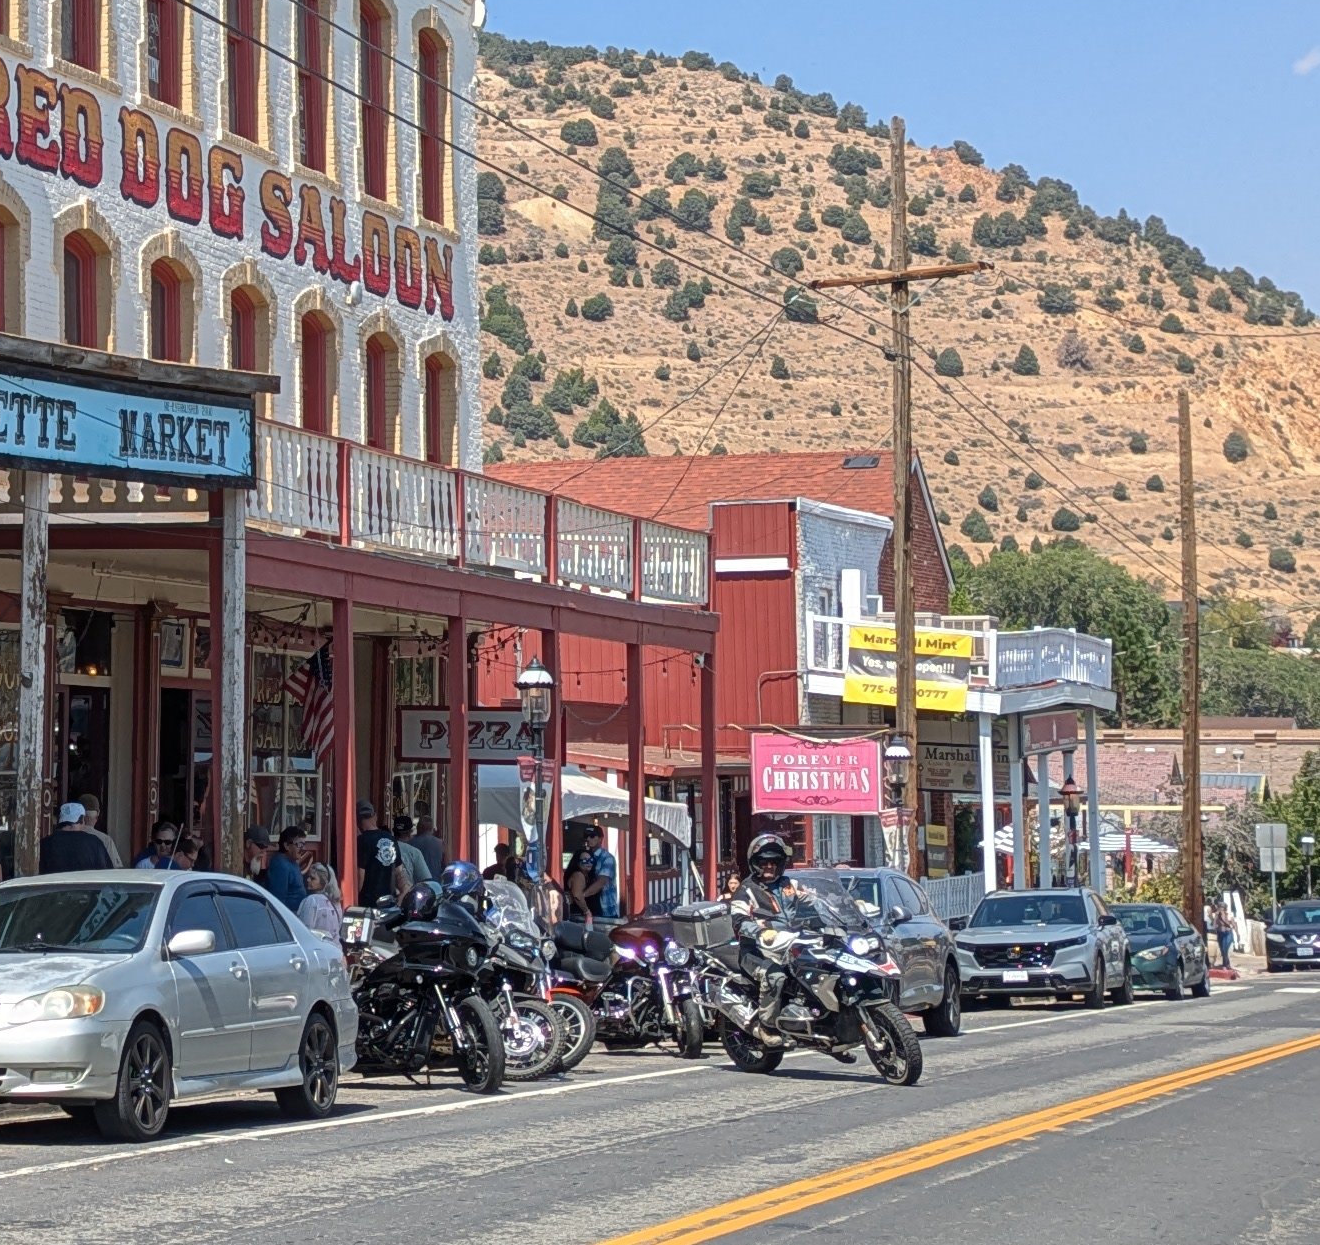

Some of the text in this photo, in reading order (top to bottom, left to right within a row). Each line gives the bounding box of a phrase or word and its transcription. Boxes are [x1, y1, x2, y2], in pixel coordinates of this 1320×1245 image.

[119, 106, 245, 241] DOG
[261, 170, 455, 322] SALOON
[119, 408, 231, 466] MARKET
[926, 639, 958, 650] Mint
[862, 656, 883, 668] Yes,
[419, 719, 535, 750] PZZA
[772, 755, 859, 765] FOREVER
[924, 747, 981, 763] Marshall
[762, 767, 870, 793] CHRISTMAS
